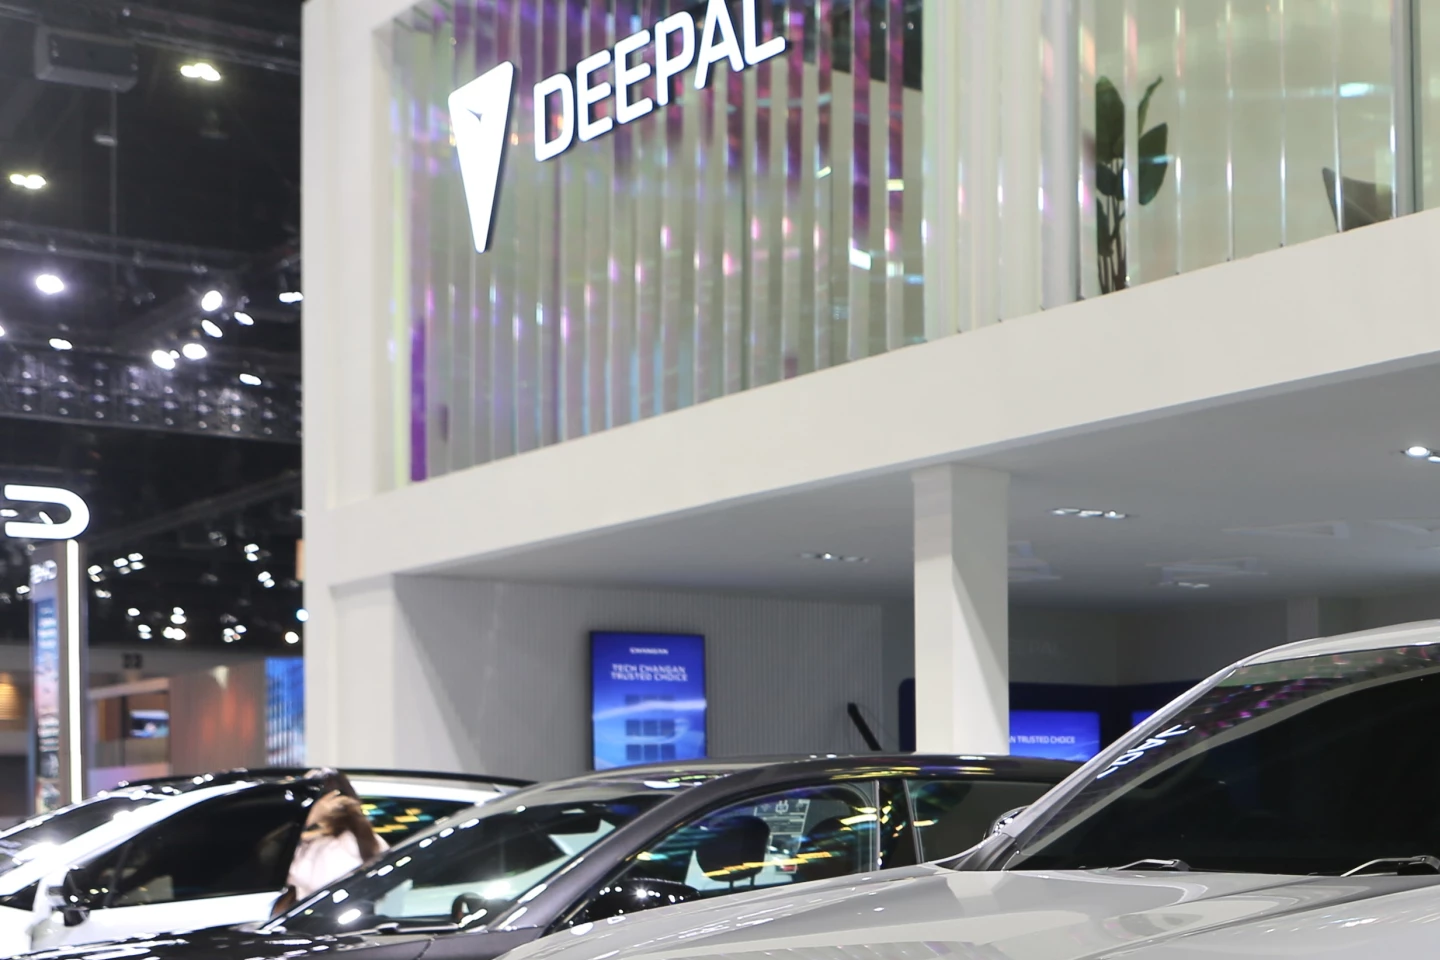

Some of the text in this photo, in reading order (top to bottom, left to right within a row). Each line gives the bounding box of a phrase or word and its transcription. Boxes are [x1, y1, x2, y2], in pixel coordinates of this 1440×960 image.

[532, 0, 786, 162] DEEPAL
[612, 663, 686, 674] TECH CHANGAN
[611, 671, 688, 682] TRUSTED CHOICE
[1017, 735, 1050, 744] TRUSTED
[1050, 735, 1076, 744] CHOICE
